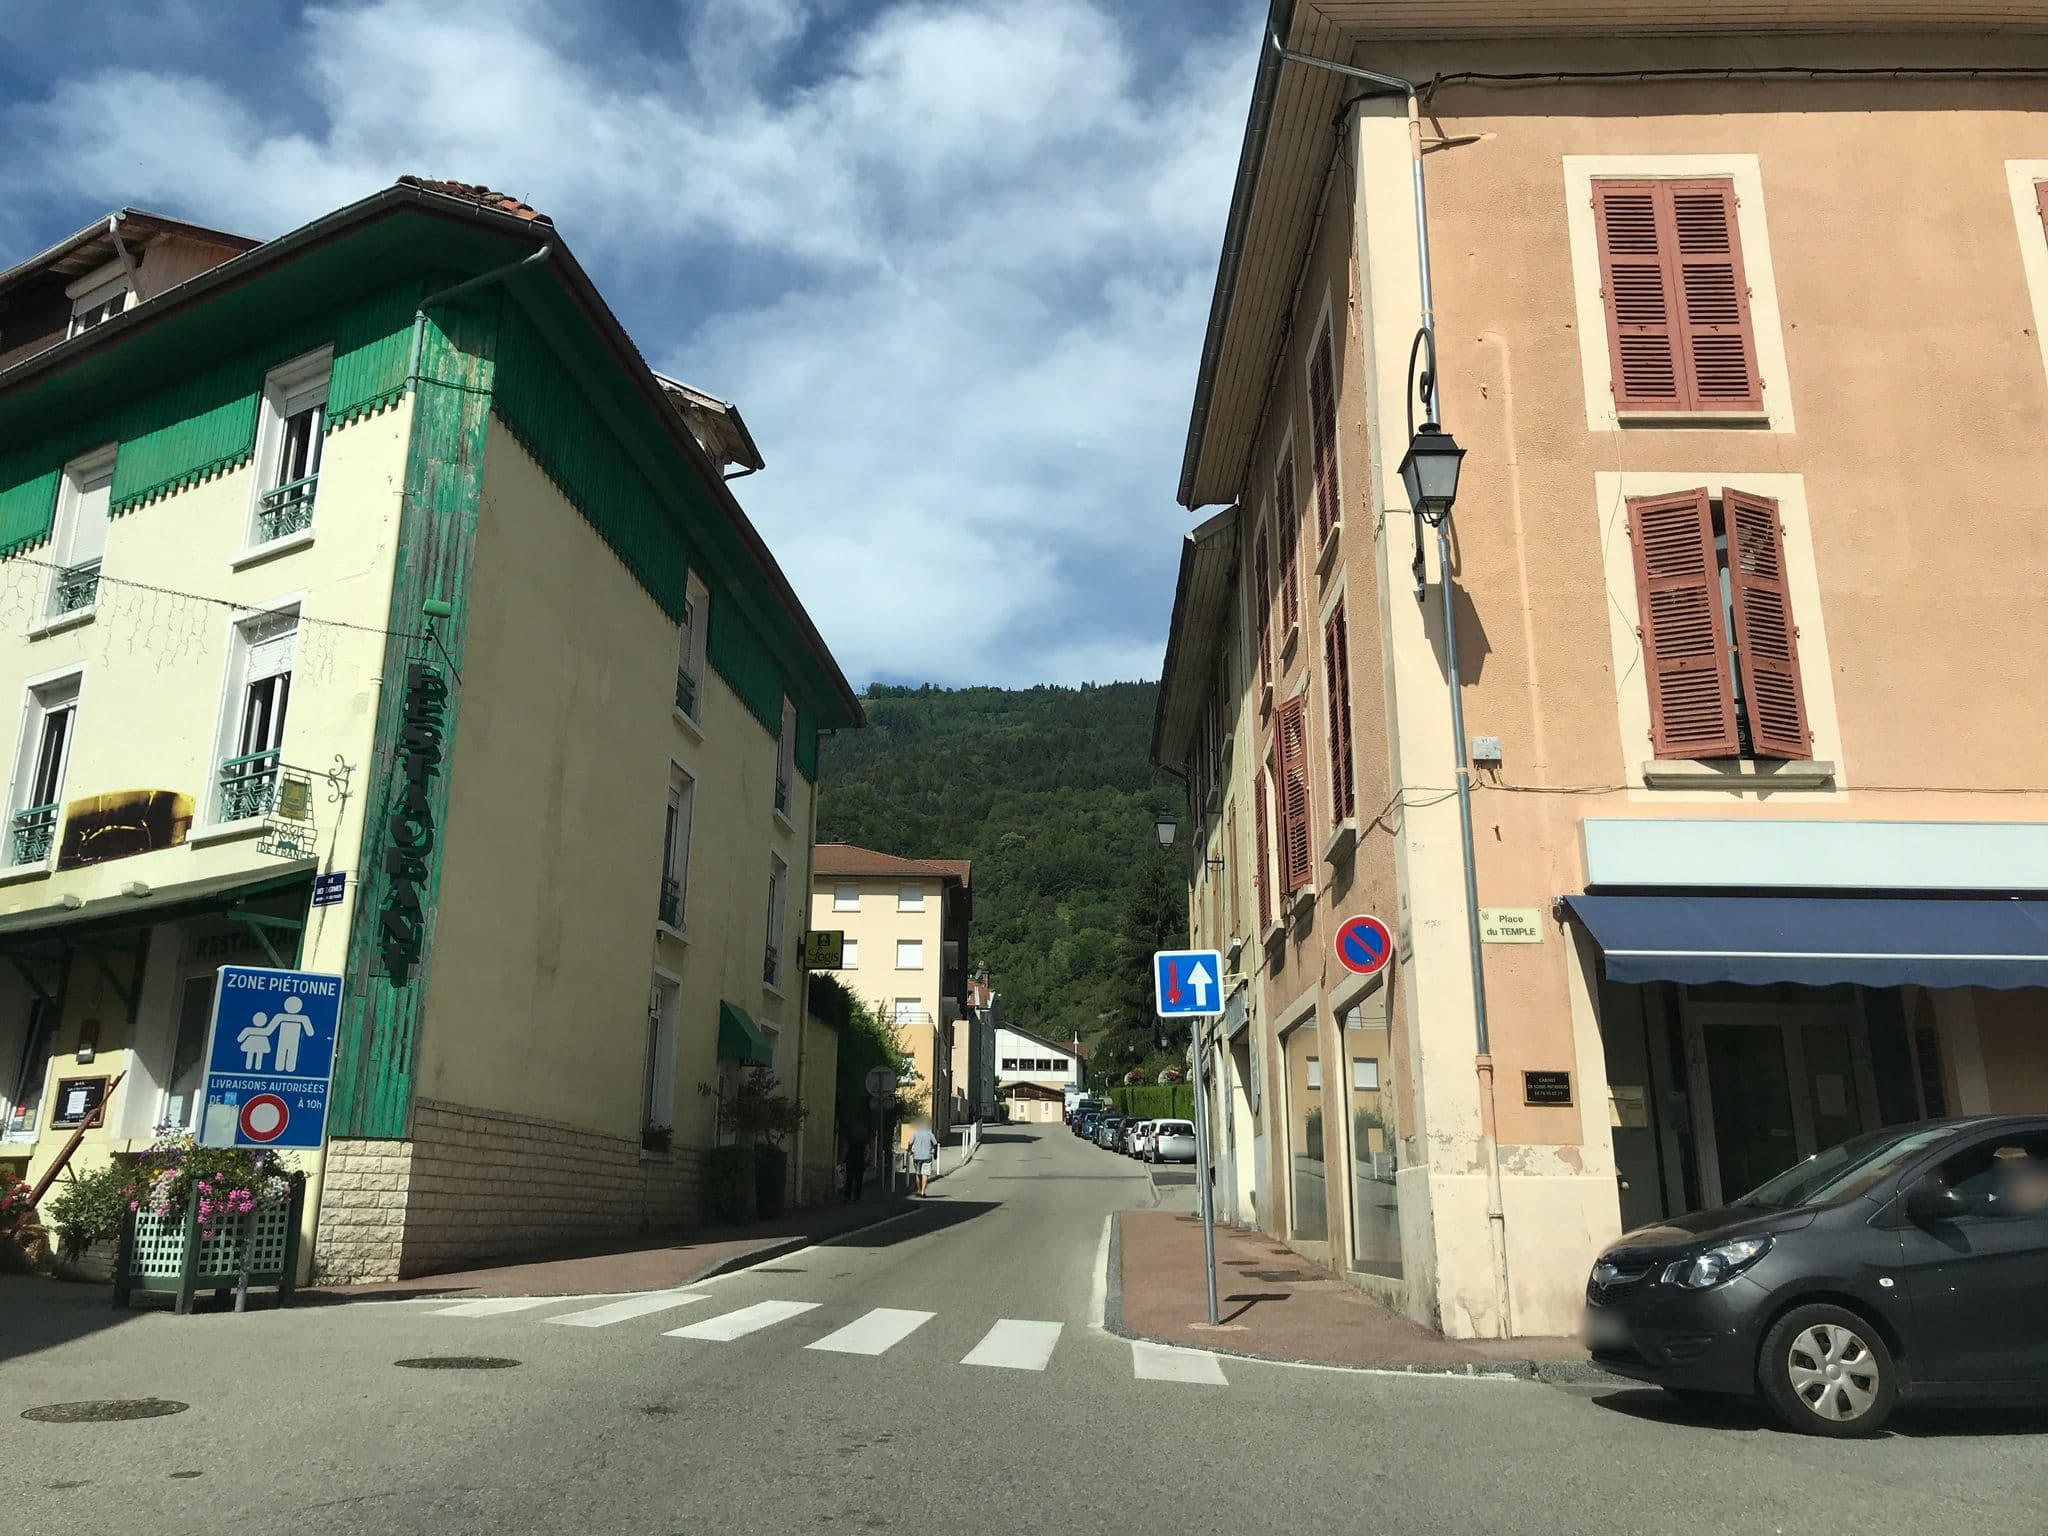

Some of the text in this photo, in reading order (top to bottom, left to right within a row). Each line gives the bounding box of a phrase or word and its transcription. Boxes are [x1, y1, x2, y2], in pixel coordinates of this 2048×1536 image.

[382, 662, 448, 988] RESTAURANT
[1499, 915, 1524, 923] Place
[1486, 928, 1537, 936] du TEMPLE
[808, 946, 840, 966] Logis
[227, 973, 337, 996] ZONE PIÉTONNE
[210, 1078, 325, 1093] LIVRAISONS AUTORISÉES
[209, 1094, 222, 1105] DE
[297, 1098, 304, 1109] À
[306, 1099, 322, 1109] 10h
